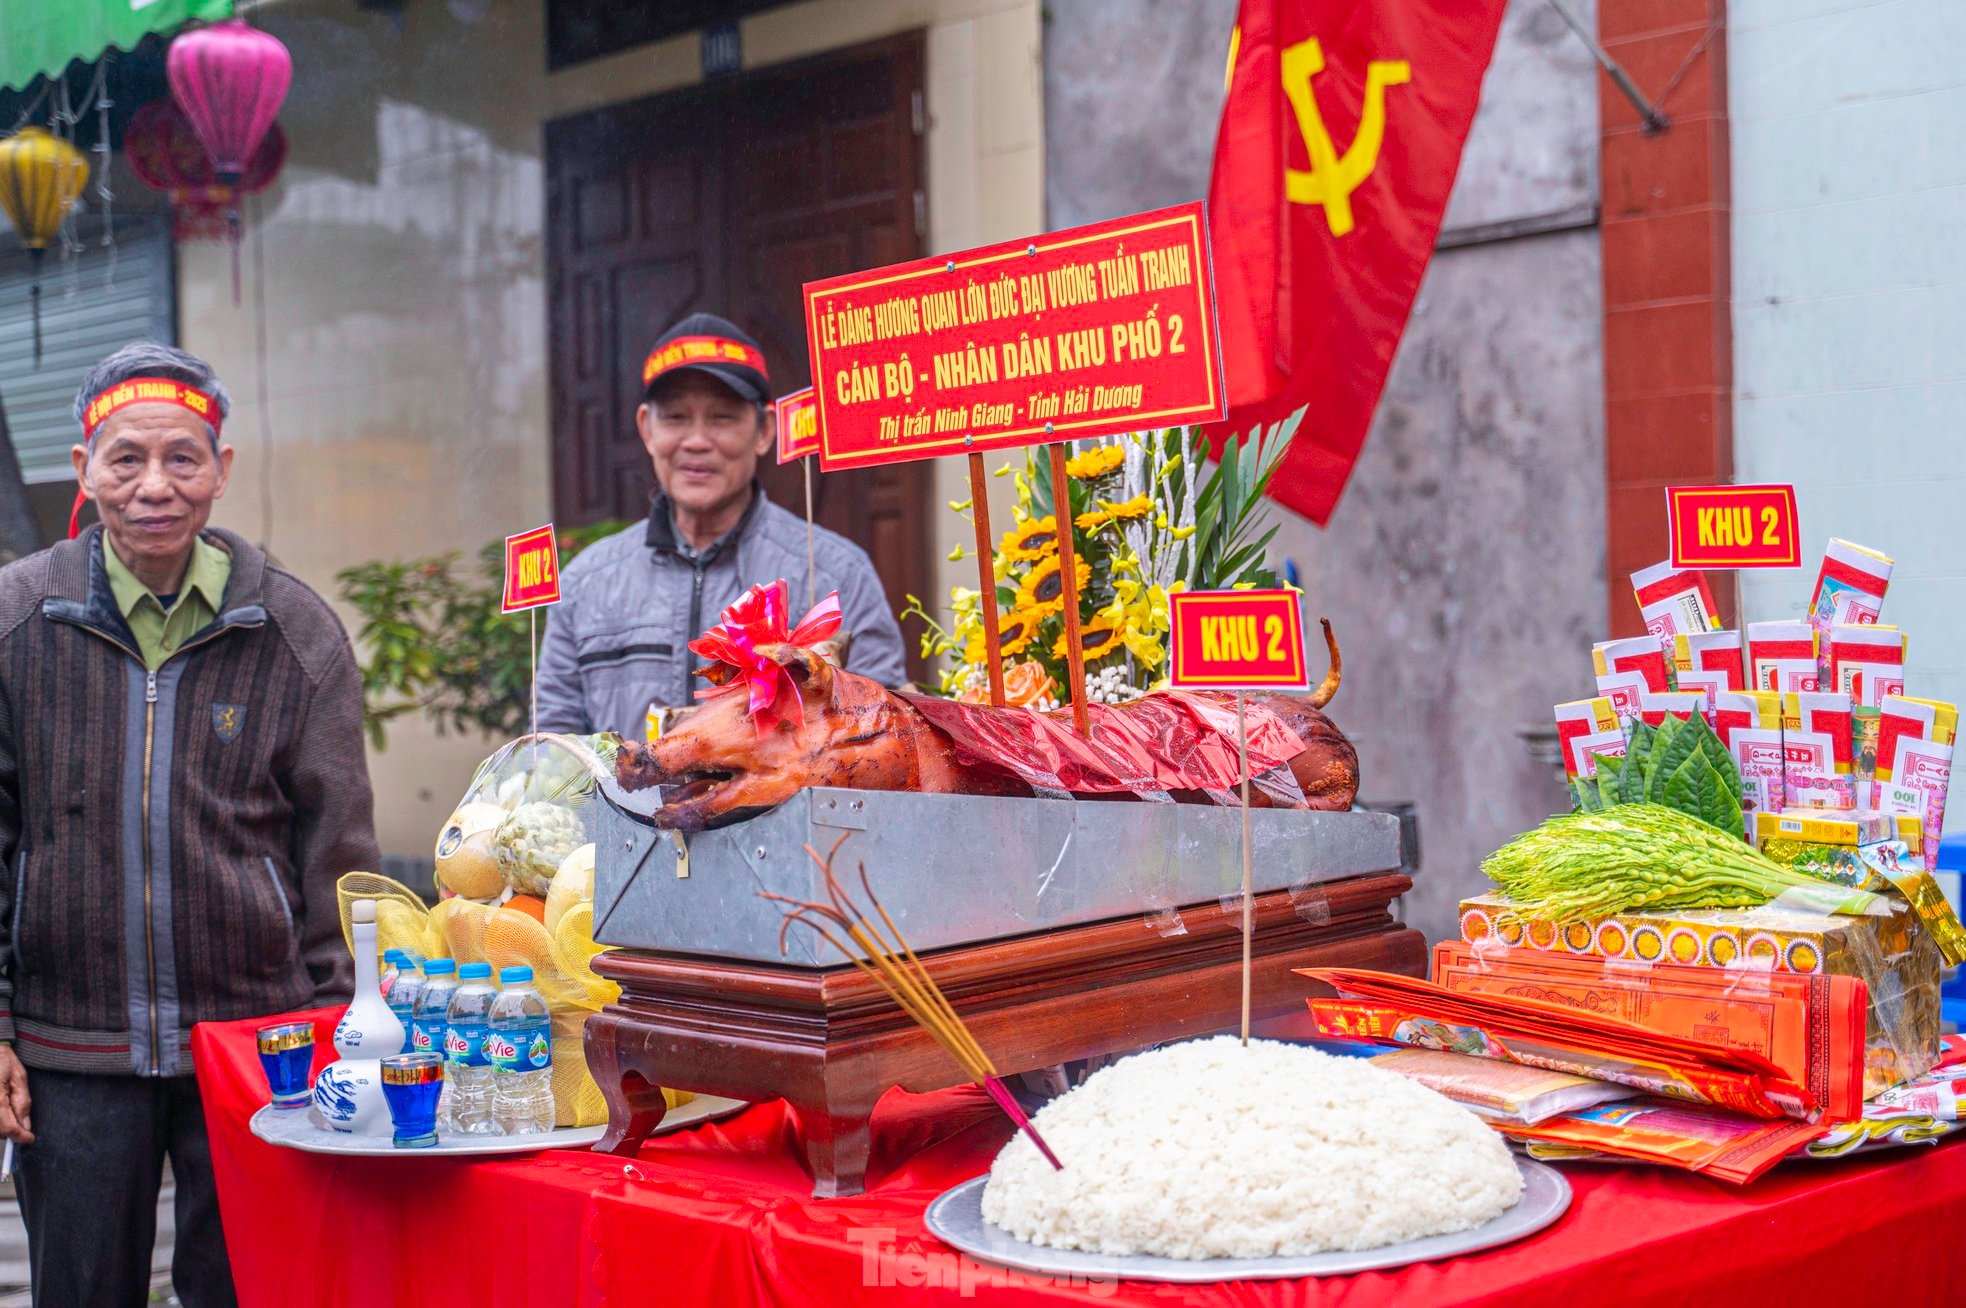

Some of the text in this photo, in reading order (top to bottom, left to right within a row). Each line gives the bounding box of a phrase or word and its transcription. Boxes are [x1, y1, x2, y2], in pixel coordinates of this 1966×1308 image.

[820, 243, 1192, 350] LỄ DÂNG HƯƠNG QUAN LỚN ĐỨC ĐẠI VƯƠNG TUẦN TRANH
[836, 303, 1186, 406] CÁN BỘ - NHÂN DÂN KHU PHỐ 2
[137, 382, 177, 399] TRANH
[184, 389, 208, 413] 2025
[879, 415, 901, 443] Thị
[902, 407, 932, 437] trấn
[934, 406, 968, 433] Ninh
[971, 402, 1014, 428] Giang
[1028, 391, 1060, 420] Tỉnh
[1063, 385, 1090, 415] Hải
[1092, 383, 1143, 411] Dương
[789, 403, 817, 443] KHU
[1697, 505, 1780, 547] KHU 2
[519, 547, 552, 589] KHU 2
[1200, 614, 1287, 662] KHU 2
